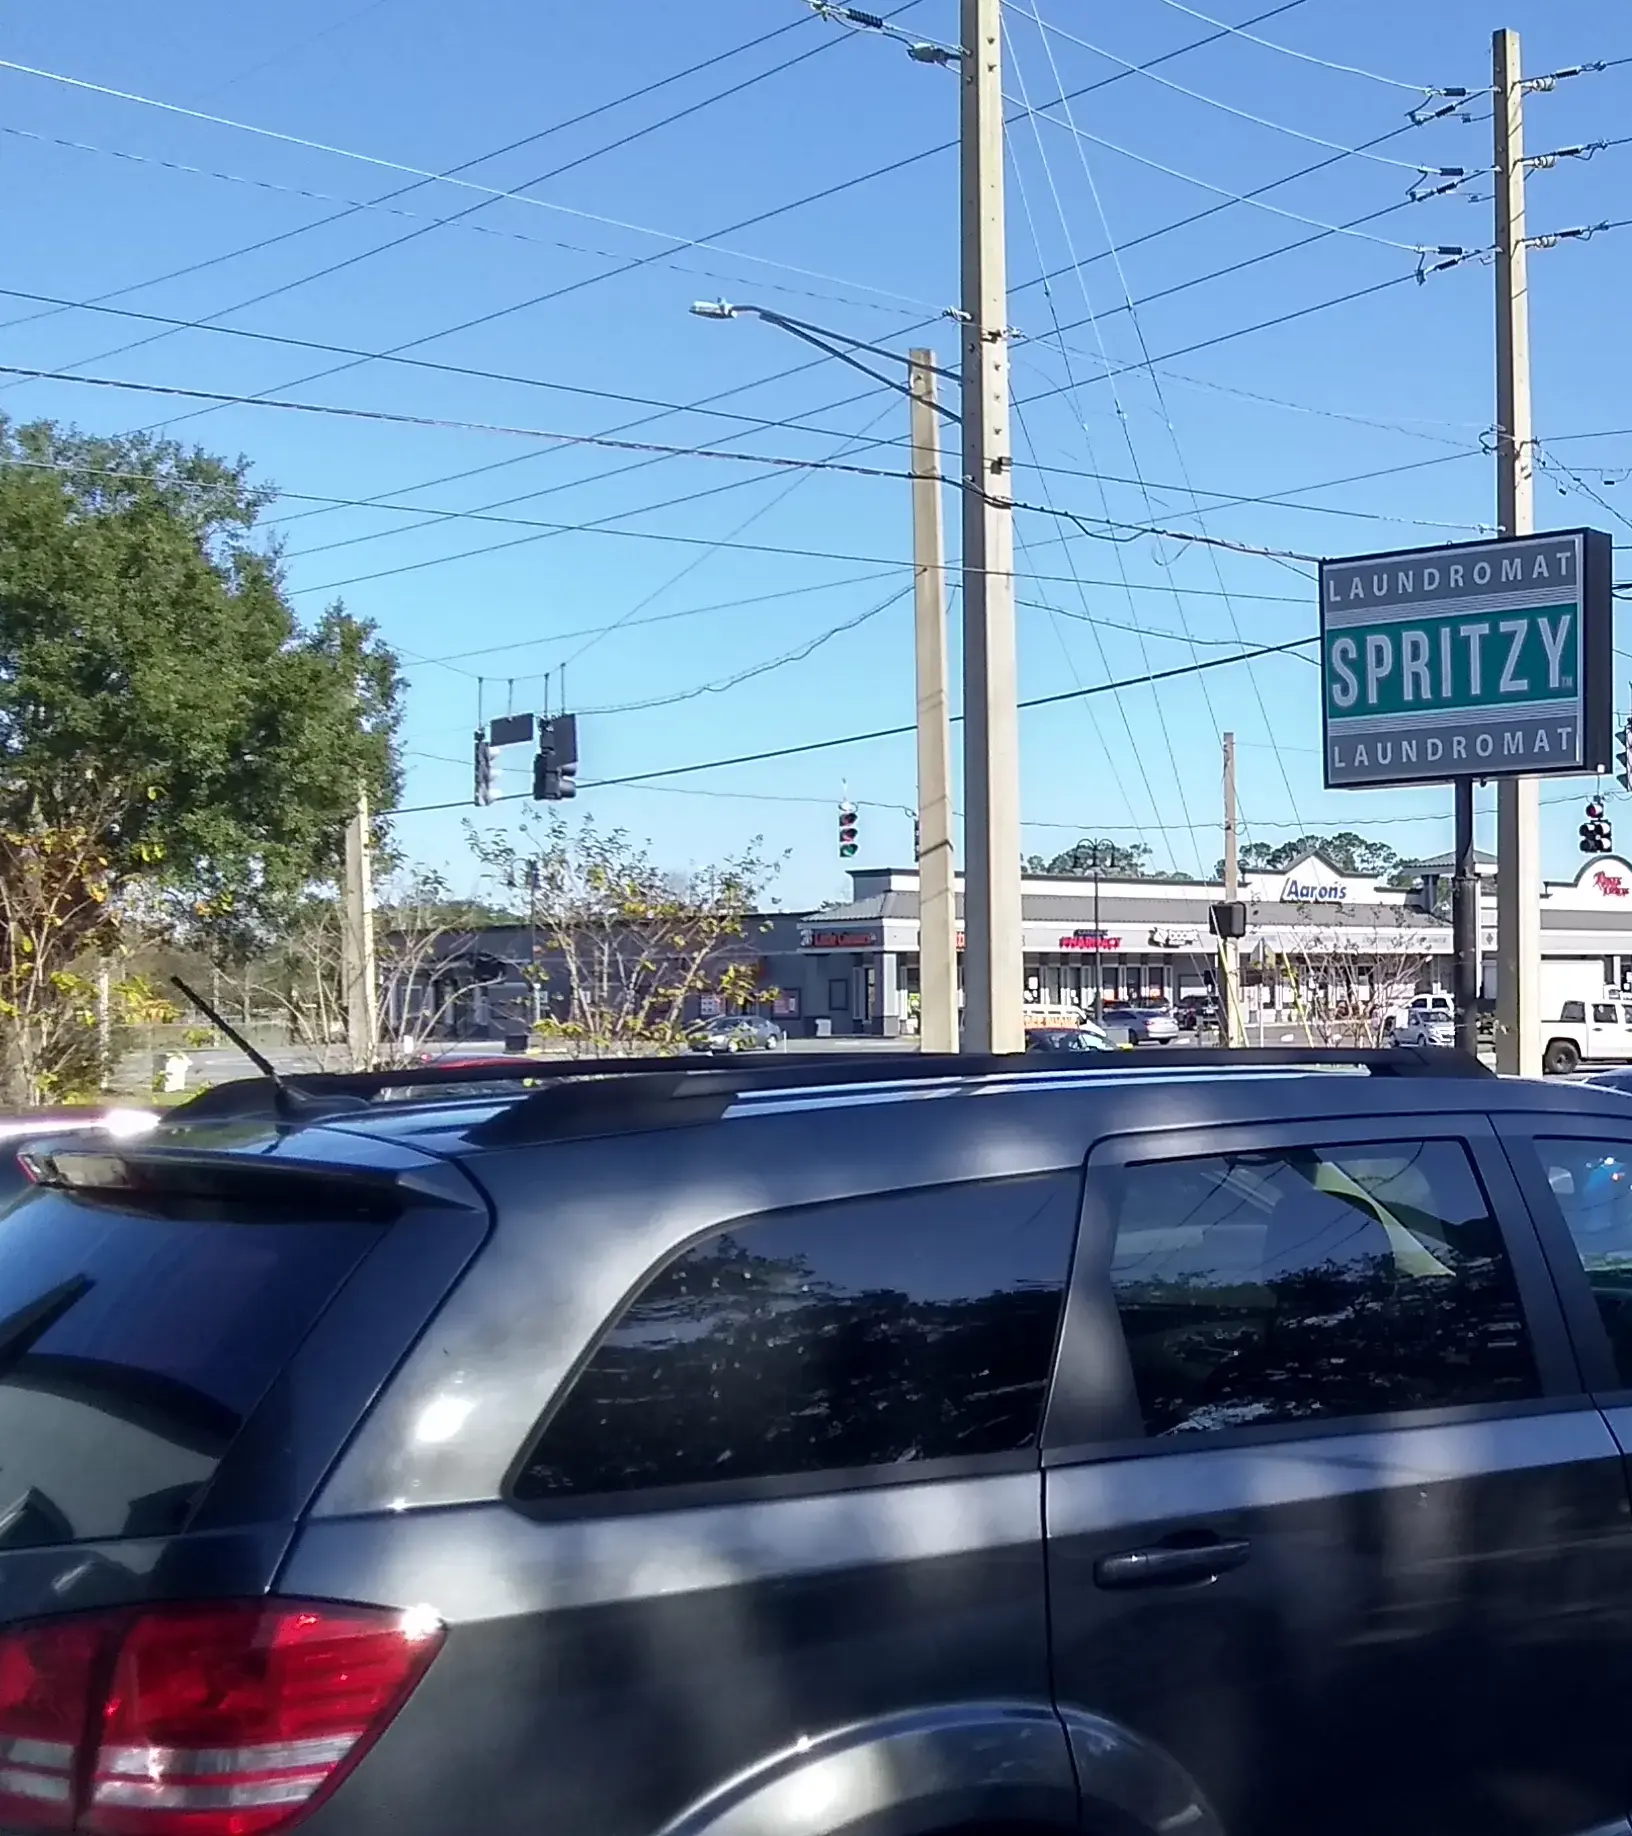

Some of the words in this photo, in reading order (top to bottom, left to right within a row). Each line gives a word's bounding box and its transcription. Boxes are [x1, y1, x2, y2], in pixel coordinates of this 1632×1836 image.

[1329, 551, 1571, 602] LAUNDROMAT
[1331, 614, 1572, 708] SPRITZY
[1334, 727, 1573, 768] LAUNDROMAT
